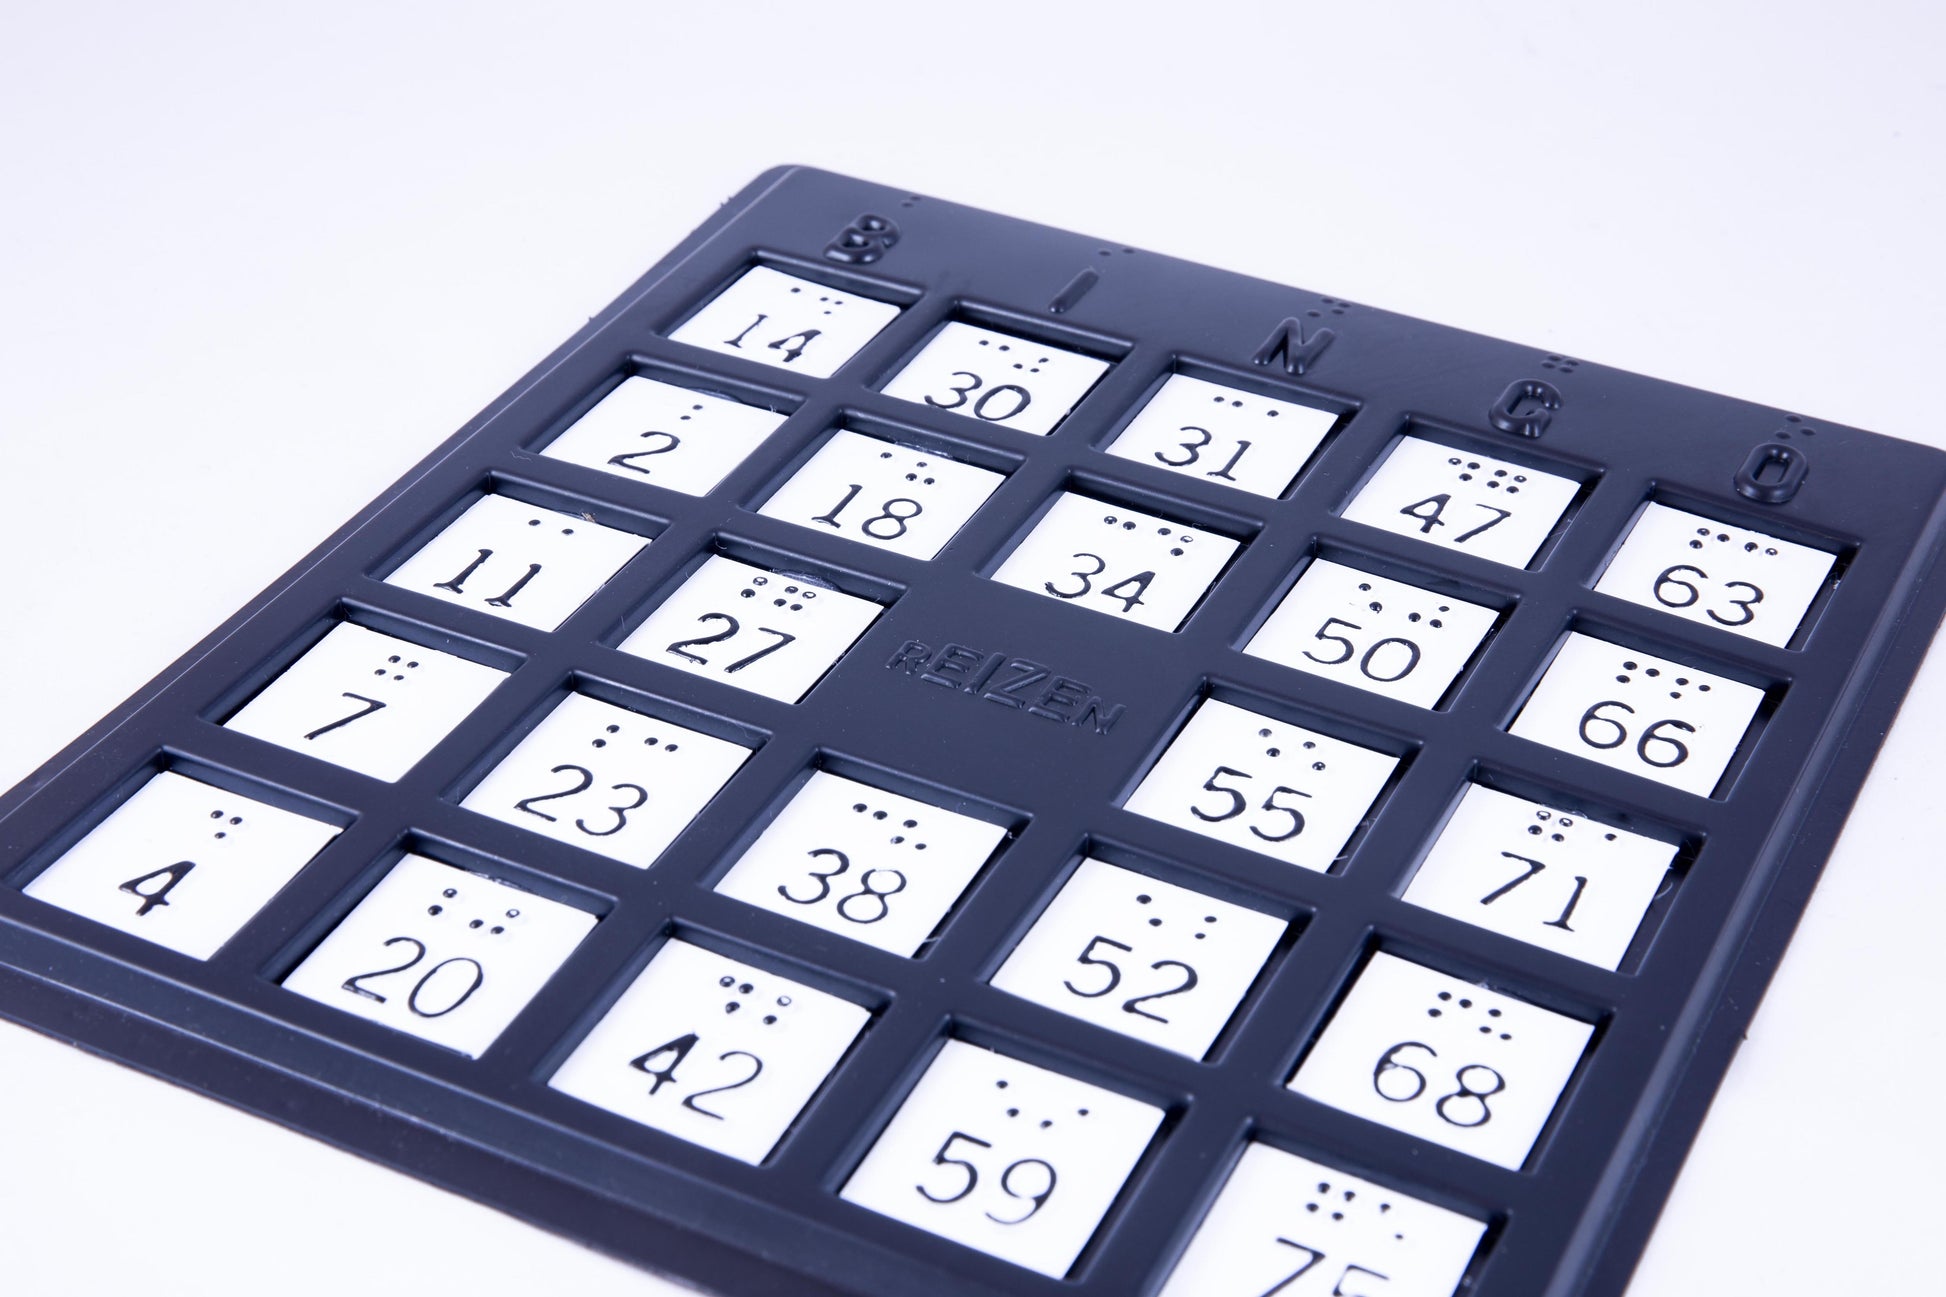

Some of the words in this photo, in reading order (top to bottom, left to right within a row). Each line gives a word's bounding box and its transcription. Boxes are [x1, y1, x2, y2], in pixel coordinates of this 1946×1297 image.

[723, 315, 823, 363] 14
[823, 213, 901, 265] B
[1048, 267, 1100, 314] I
[1252, 316, 1336, 375] N
[1489, 378, 1562, 439] G
[1733, 442, 1809, 503] O
[923, 372, 1033, 425] 30
[607, 432, 680, 475] 2
[1153, 427, 1251, 483] 31
[811, 484, 923, 541] 18
[1399, 493, 1512, 544] 47
[432, 549, 542, 608] 11
[1044, 553, 1157, 613] 34
[1653, 565, 1765, 627] 63
[666, 613, 797, 674] 27
[1301, 617, 1422, 683] 50
[304, 693, 387, 742] 7
[885, 640, 1127, 736] REIZEN
[1577, 701, 1697, 769] 66
[514, 765, 649, 837] 23
[1190, 767, 1312, 843] 55
[118, 860, 197, 917] 4
[777, 849, 907, 925] 38
[1480, 853, 1588, 932] 71
[341, 938, 484, 1019] 20
[1063, 935, 1199, 1025] 52
[629, 1033, 764, 1122] 42
[1373, 1042, 1506, 1128] 68
[916, 1131, 1057, 1225] 59
